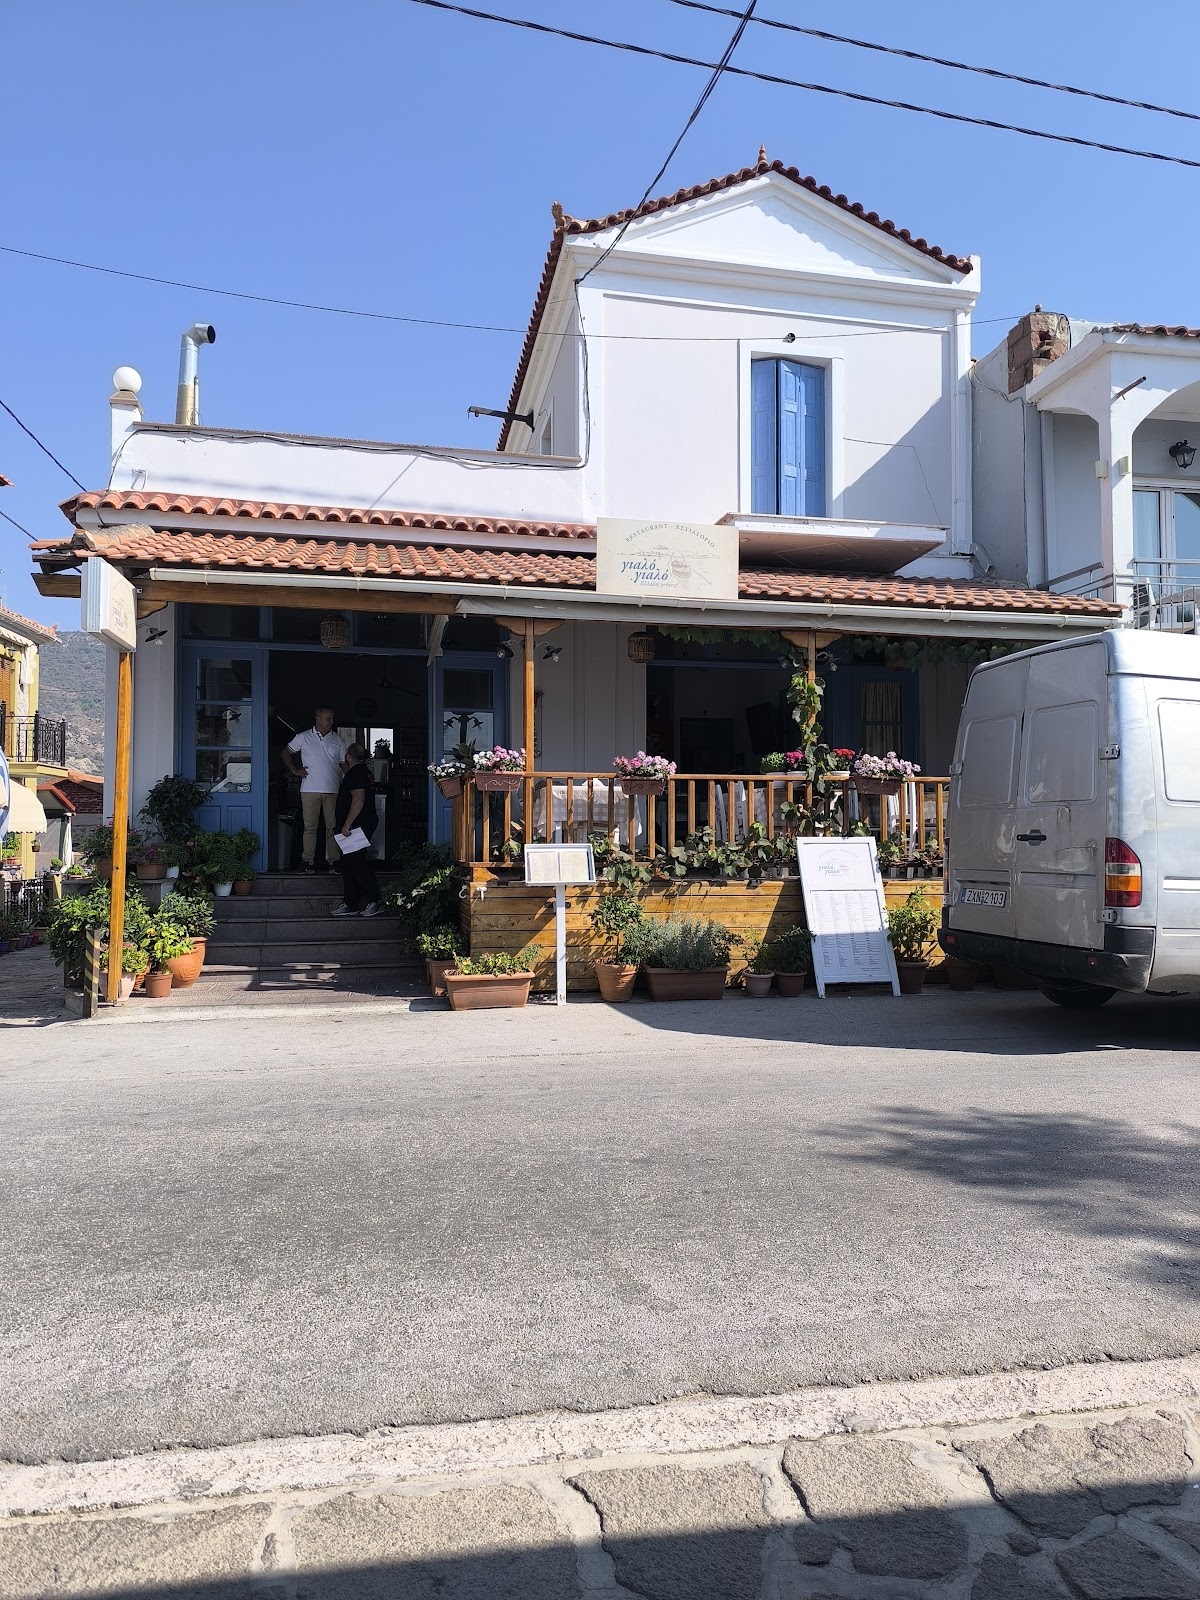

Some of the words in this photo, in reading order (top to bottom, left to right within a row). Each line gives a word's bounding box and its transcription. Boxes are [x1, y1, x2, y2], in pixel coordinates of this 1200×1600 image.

[625, 523, 669, 543] RESTAURANT
[676, 524, 716, 548] ΕΣΤΙΑΤΟΡΙΟ
[620, 558, 657, 573] γιαλό
[633, 568, 669, 583] γιαλό
